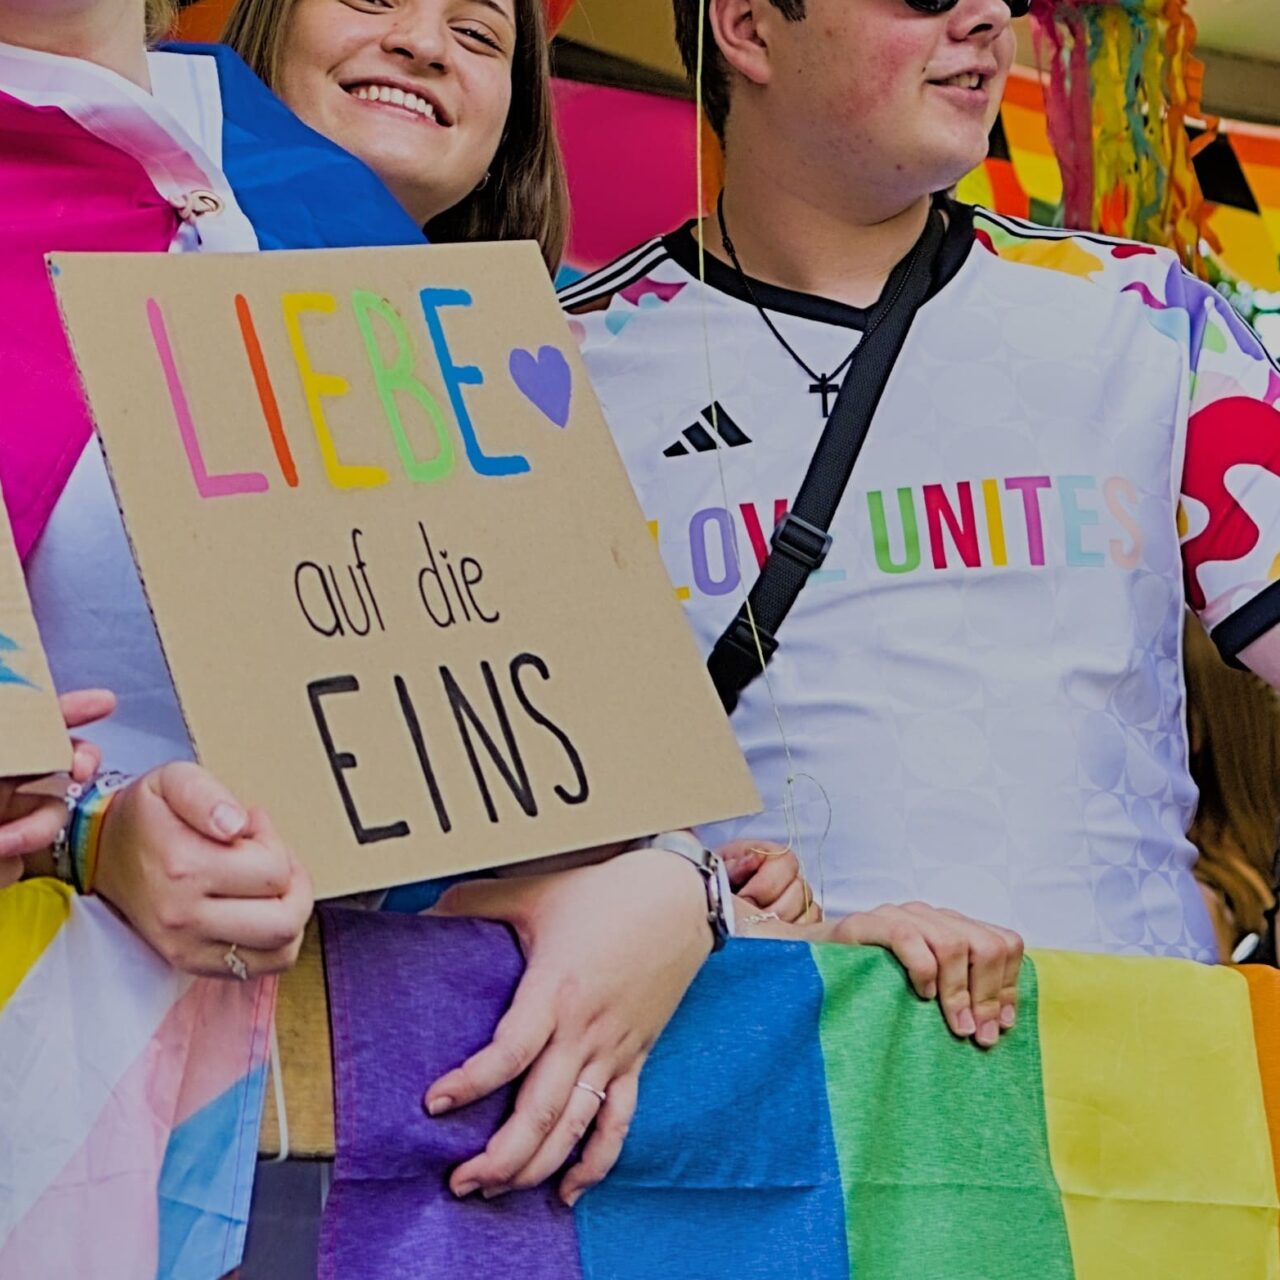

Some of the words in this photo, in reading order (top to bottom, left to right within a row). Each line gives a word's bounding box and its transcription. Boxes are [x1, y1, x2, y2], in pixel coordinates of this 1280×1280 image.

[147, 288, 531, 499] LIEBE
[294, 529, 386, 637] auf
[418, 521, 500, 628] die
[866, 475, 1144, 574] UNITES
[307, 652, 590, 845] EINS
